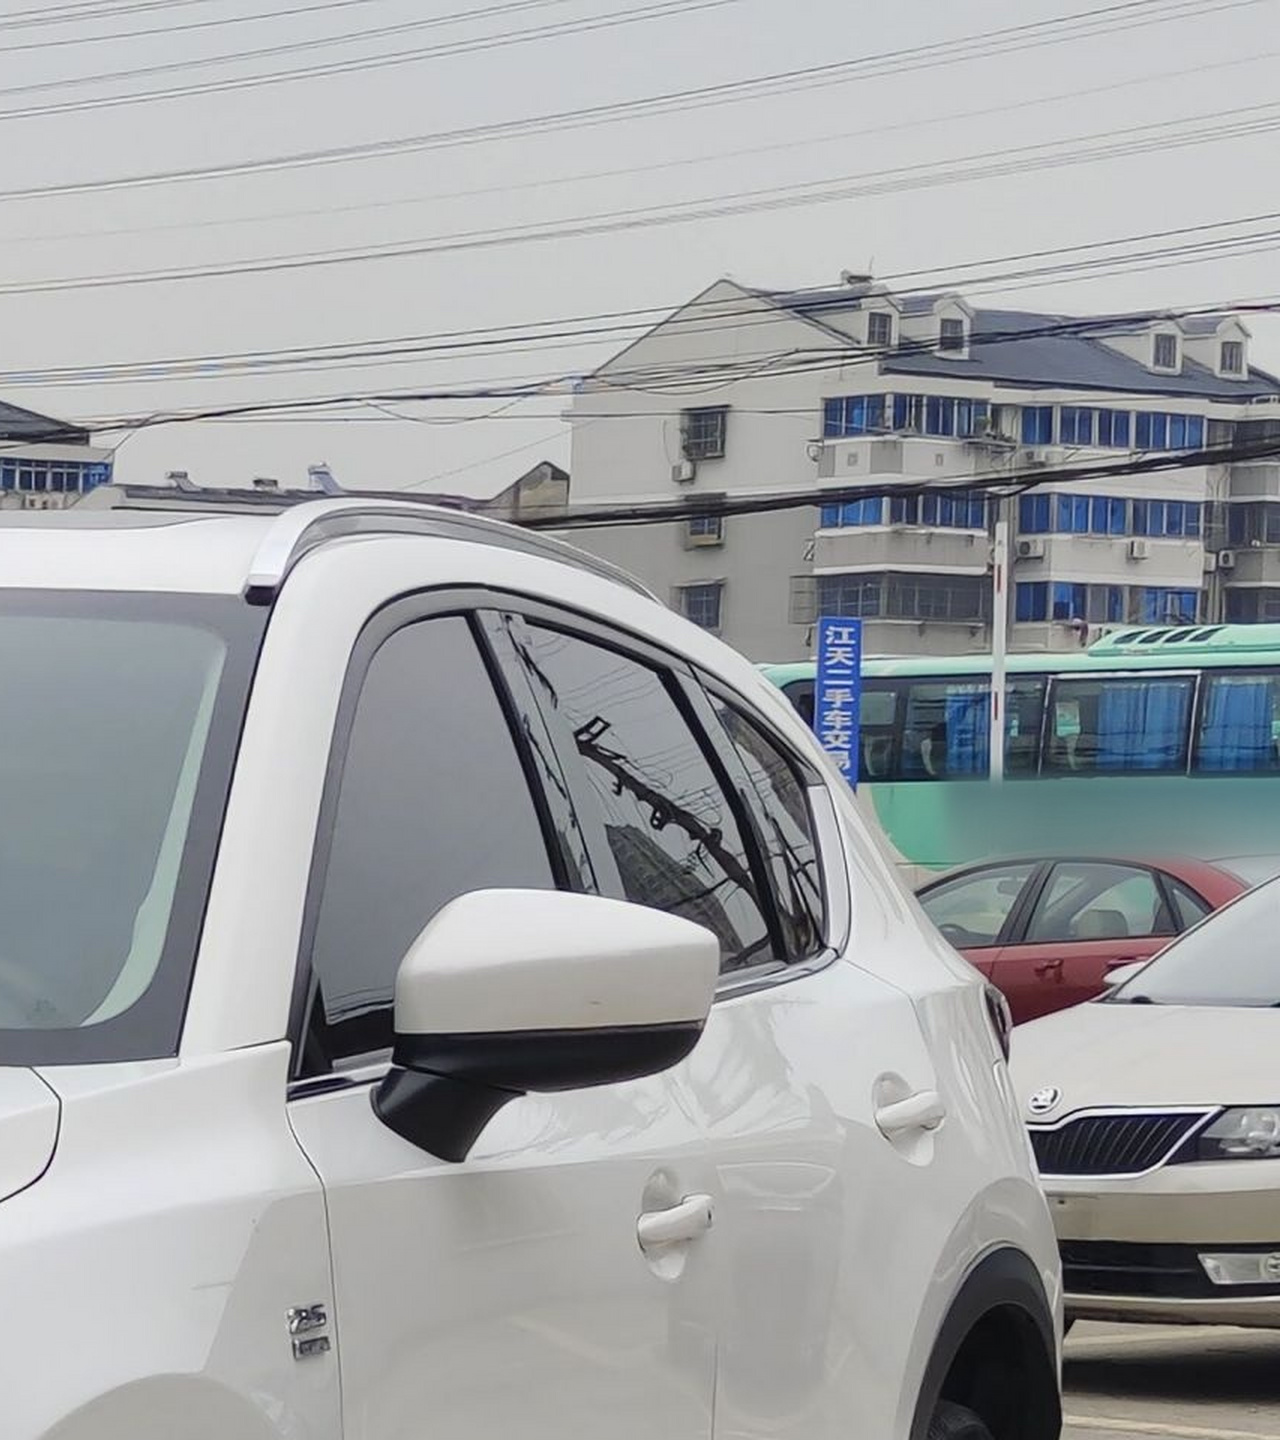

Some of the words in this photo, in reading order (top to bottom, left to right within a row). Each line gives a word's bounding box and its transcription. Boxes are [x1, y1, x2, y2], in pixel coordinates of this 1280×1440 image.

[821, 625, 856, 781] 江天二手车交易
